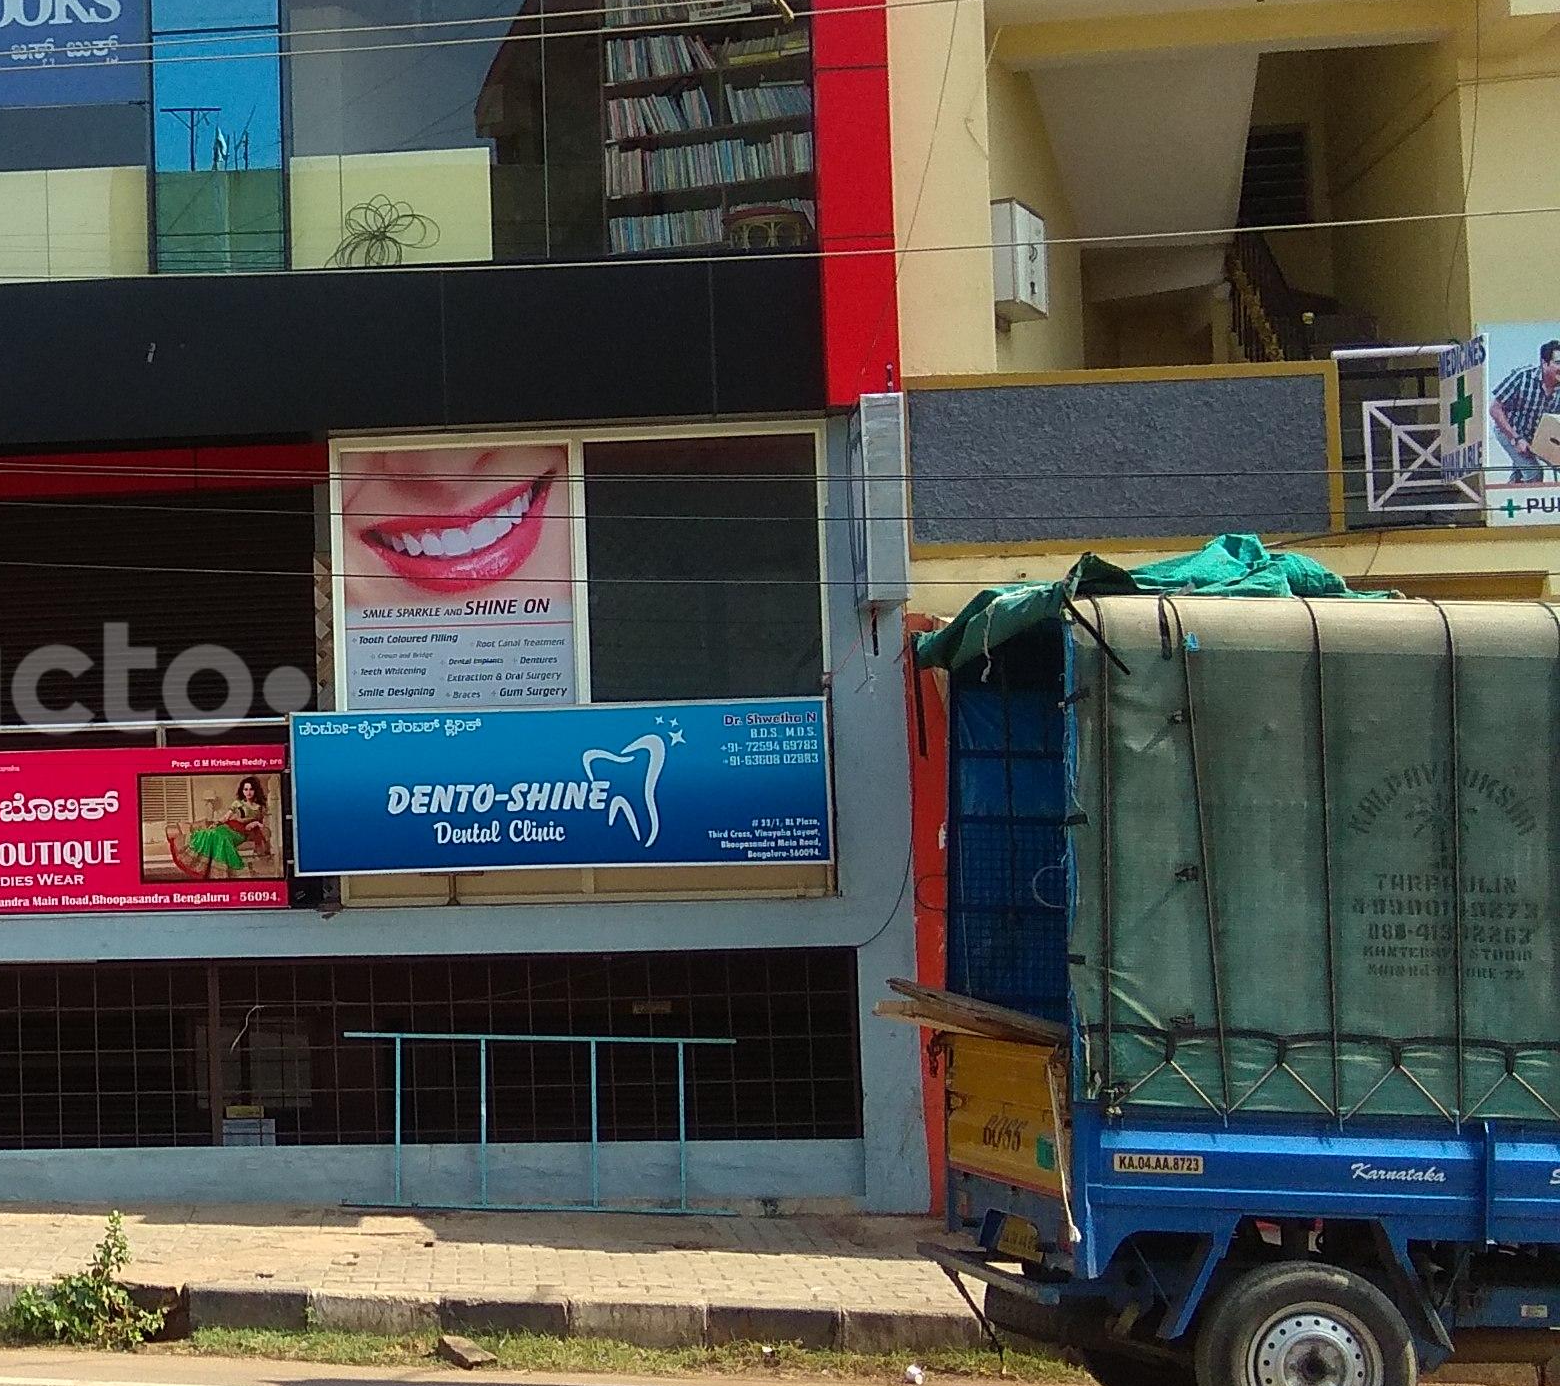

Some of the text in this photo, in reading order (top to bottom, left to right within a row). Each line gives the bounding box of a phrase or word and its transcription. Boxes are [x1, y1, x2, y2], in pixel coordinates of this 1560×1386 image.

[1527, 497, 1560, 513] PU
[362, 598, 550, 619] SMILE SPARKLE AND SHINE ON
[359, 633, 459, 644] Tooth Coloured Filling
[476, 638, 565, 648] Root Canal Treatment
[412, 651, 433, 660] Bridge
[520, 656, 558, 664] Dentures
[360, 666, 426, 676] Teeth Whitening
[447, 671, 562, 682] Extraction & Oral Surgery
[358, 687, 435, 699] Smile Designing
[452, 690, 481, 699] Braces
[499, 686, 567, 699] Gum Surgery
[724, 711, 817, 726] Dr. Shwetha N
[387, 781, 610, 815] DENTO-SHINE
[433, 819, 566, 844] Dental Clinic
[708, 830, 728, 838] Third
[37, 874, 84, 885] WEAR
[33, 896, 58, 906] Main
[173, 893, 230, 905] Bengaluru
[1118, 1156, 1201, 1173] KA.04.AA.8723
[1350, 1161, 1447, 1184] Karnataka
